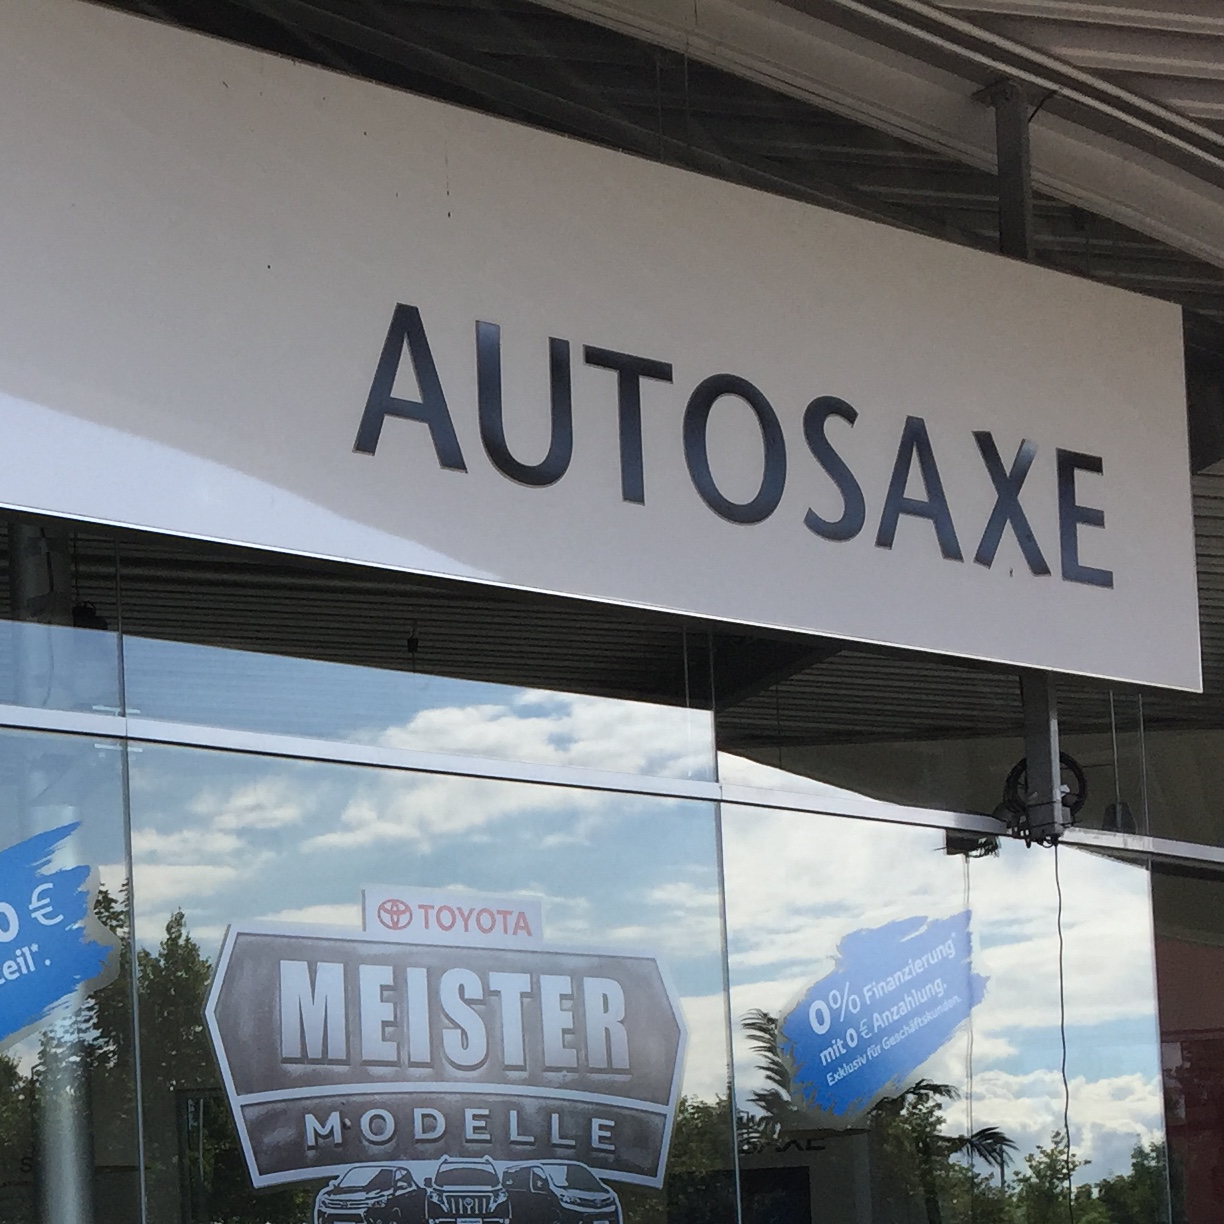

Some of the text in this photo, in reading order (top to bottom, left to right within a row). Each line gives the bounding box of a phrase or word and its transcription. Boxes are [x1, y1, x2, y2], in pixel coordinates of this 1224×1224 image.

[352, 302, 1114, 589] AUTOSAXE
[28, 882, 65, 927] €
[417, 902, 535, 938] TOYOTA
[279, 958, 632, 1074] MEISTER
[819, 976, 948, 1066] mit 0 € Anzahlung.
[826, 1054, 867, 1086] Exklusiv
[866, 1041, 882, 1064] für
[304, 1107, 616, 1152] MODELLE
